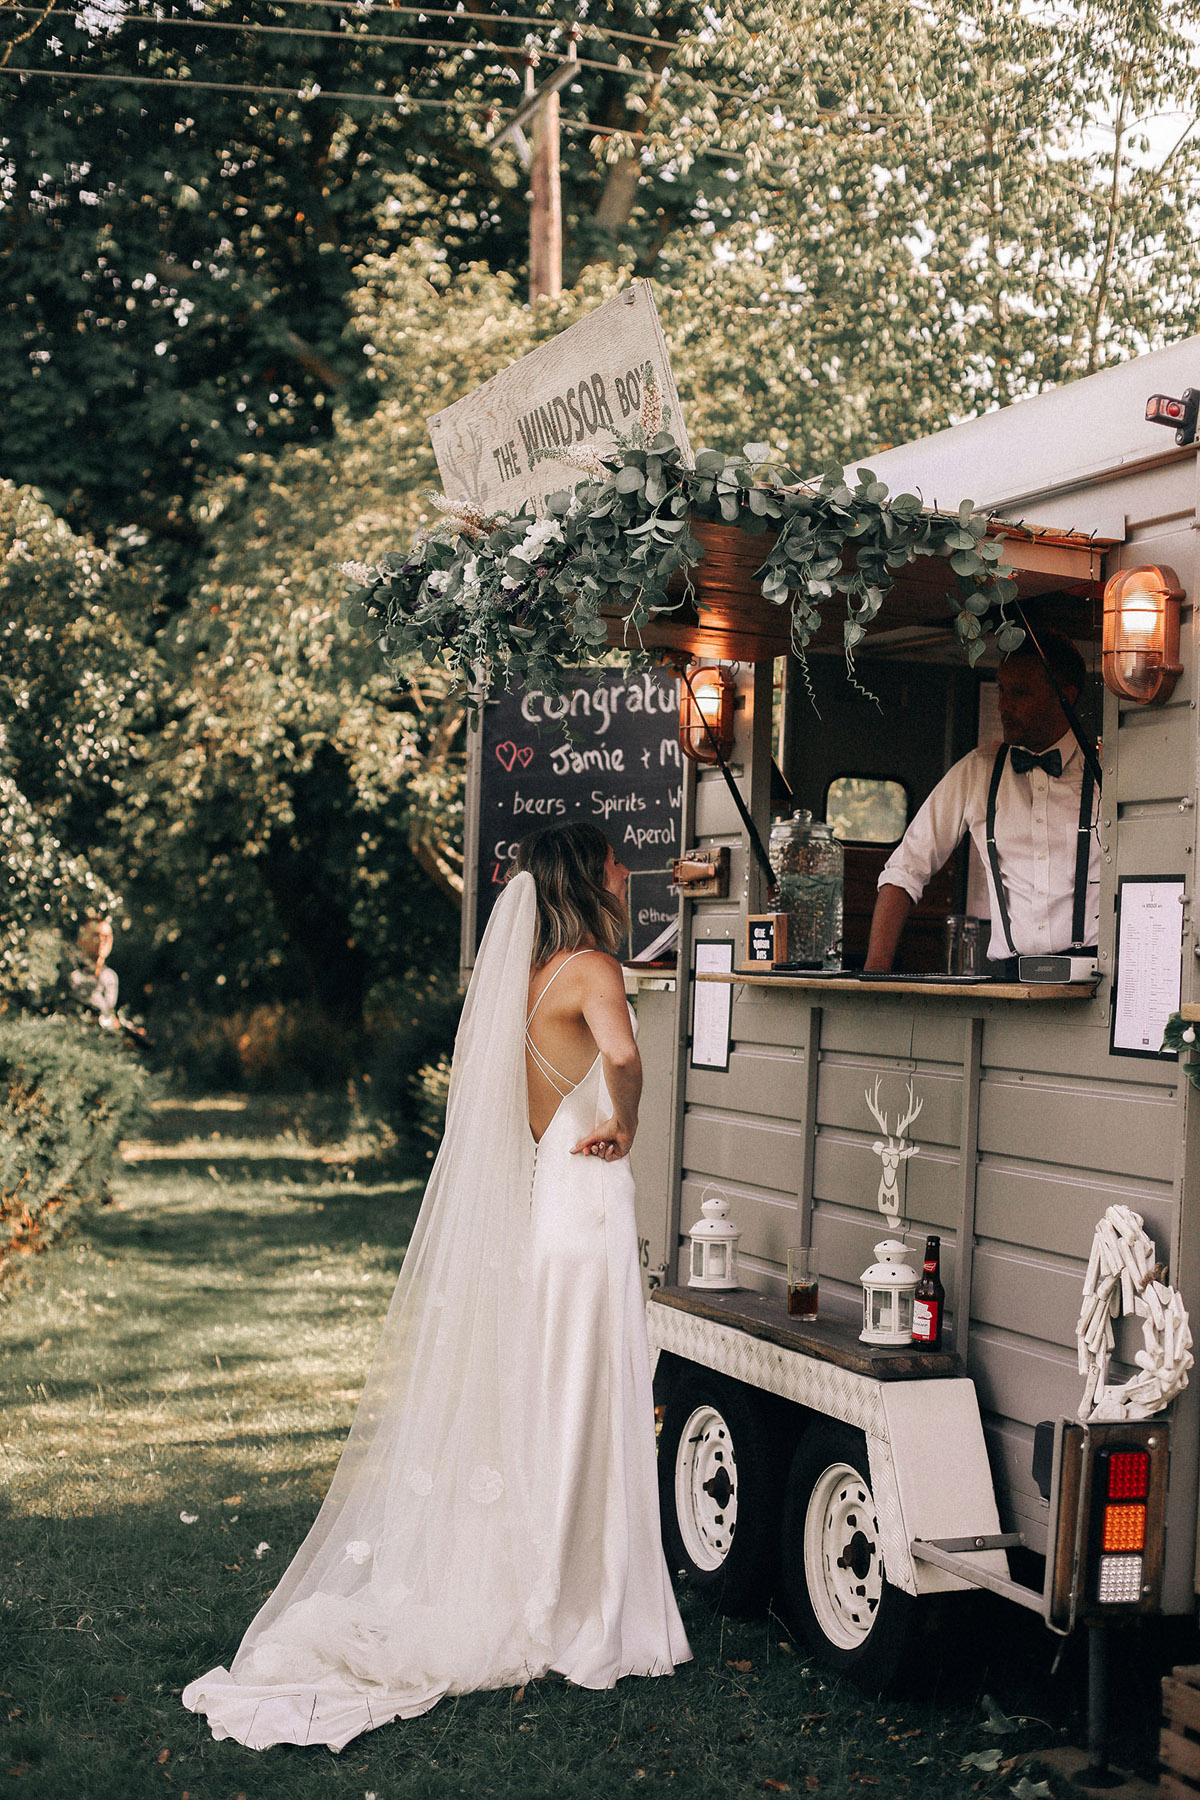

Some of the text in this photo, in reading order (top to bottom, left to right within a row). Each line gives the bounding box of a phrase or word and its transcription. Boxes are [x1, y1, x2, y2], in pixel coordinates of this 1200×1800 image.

[493, 360, 652, 482] THE WINDSOR BO
[549, 742, 625, 776] Jamie
[513, 791, 566, 815] beers
[591, 791, 647, 820] Spirits
[623, 818, 676, 849] Aperol
